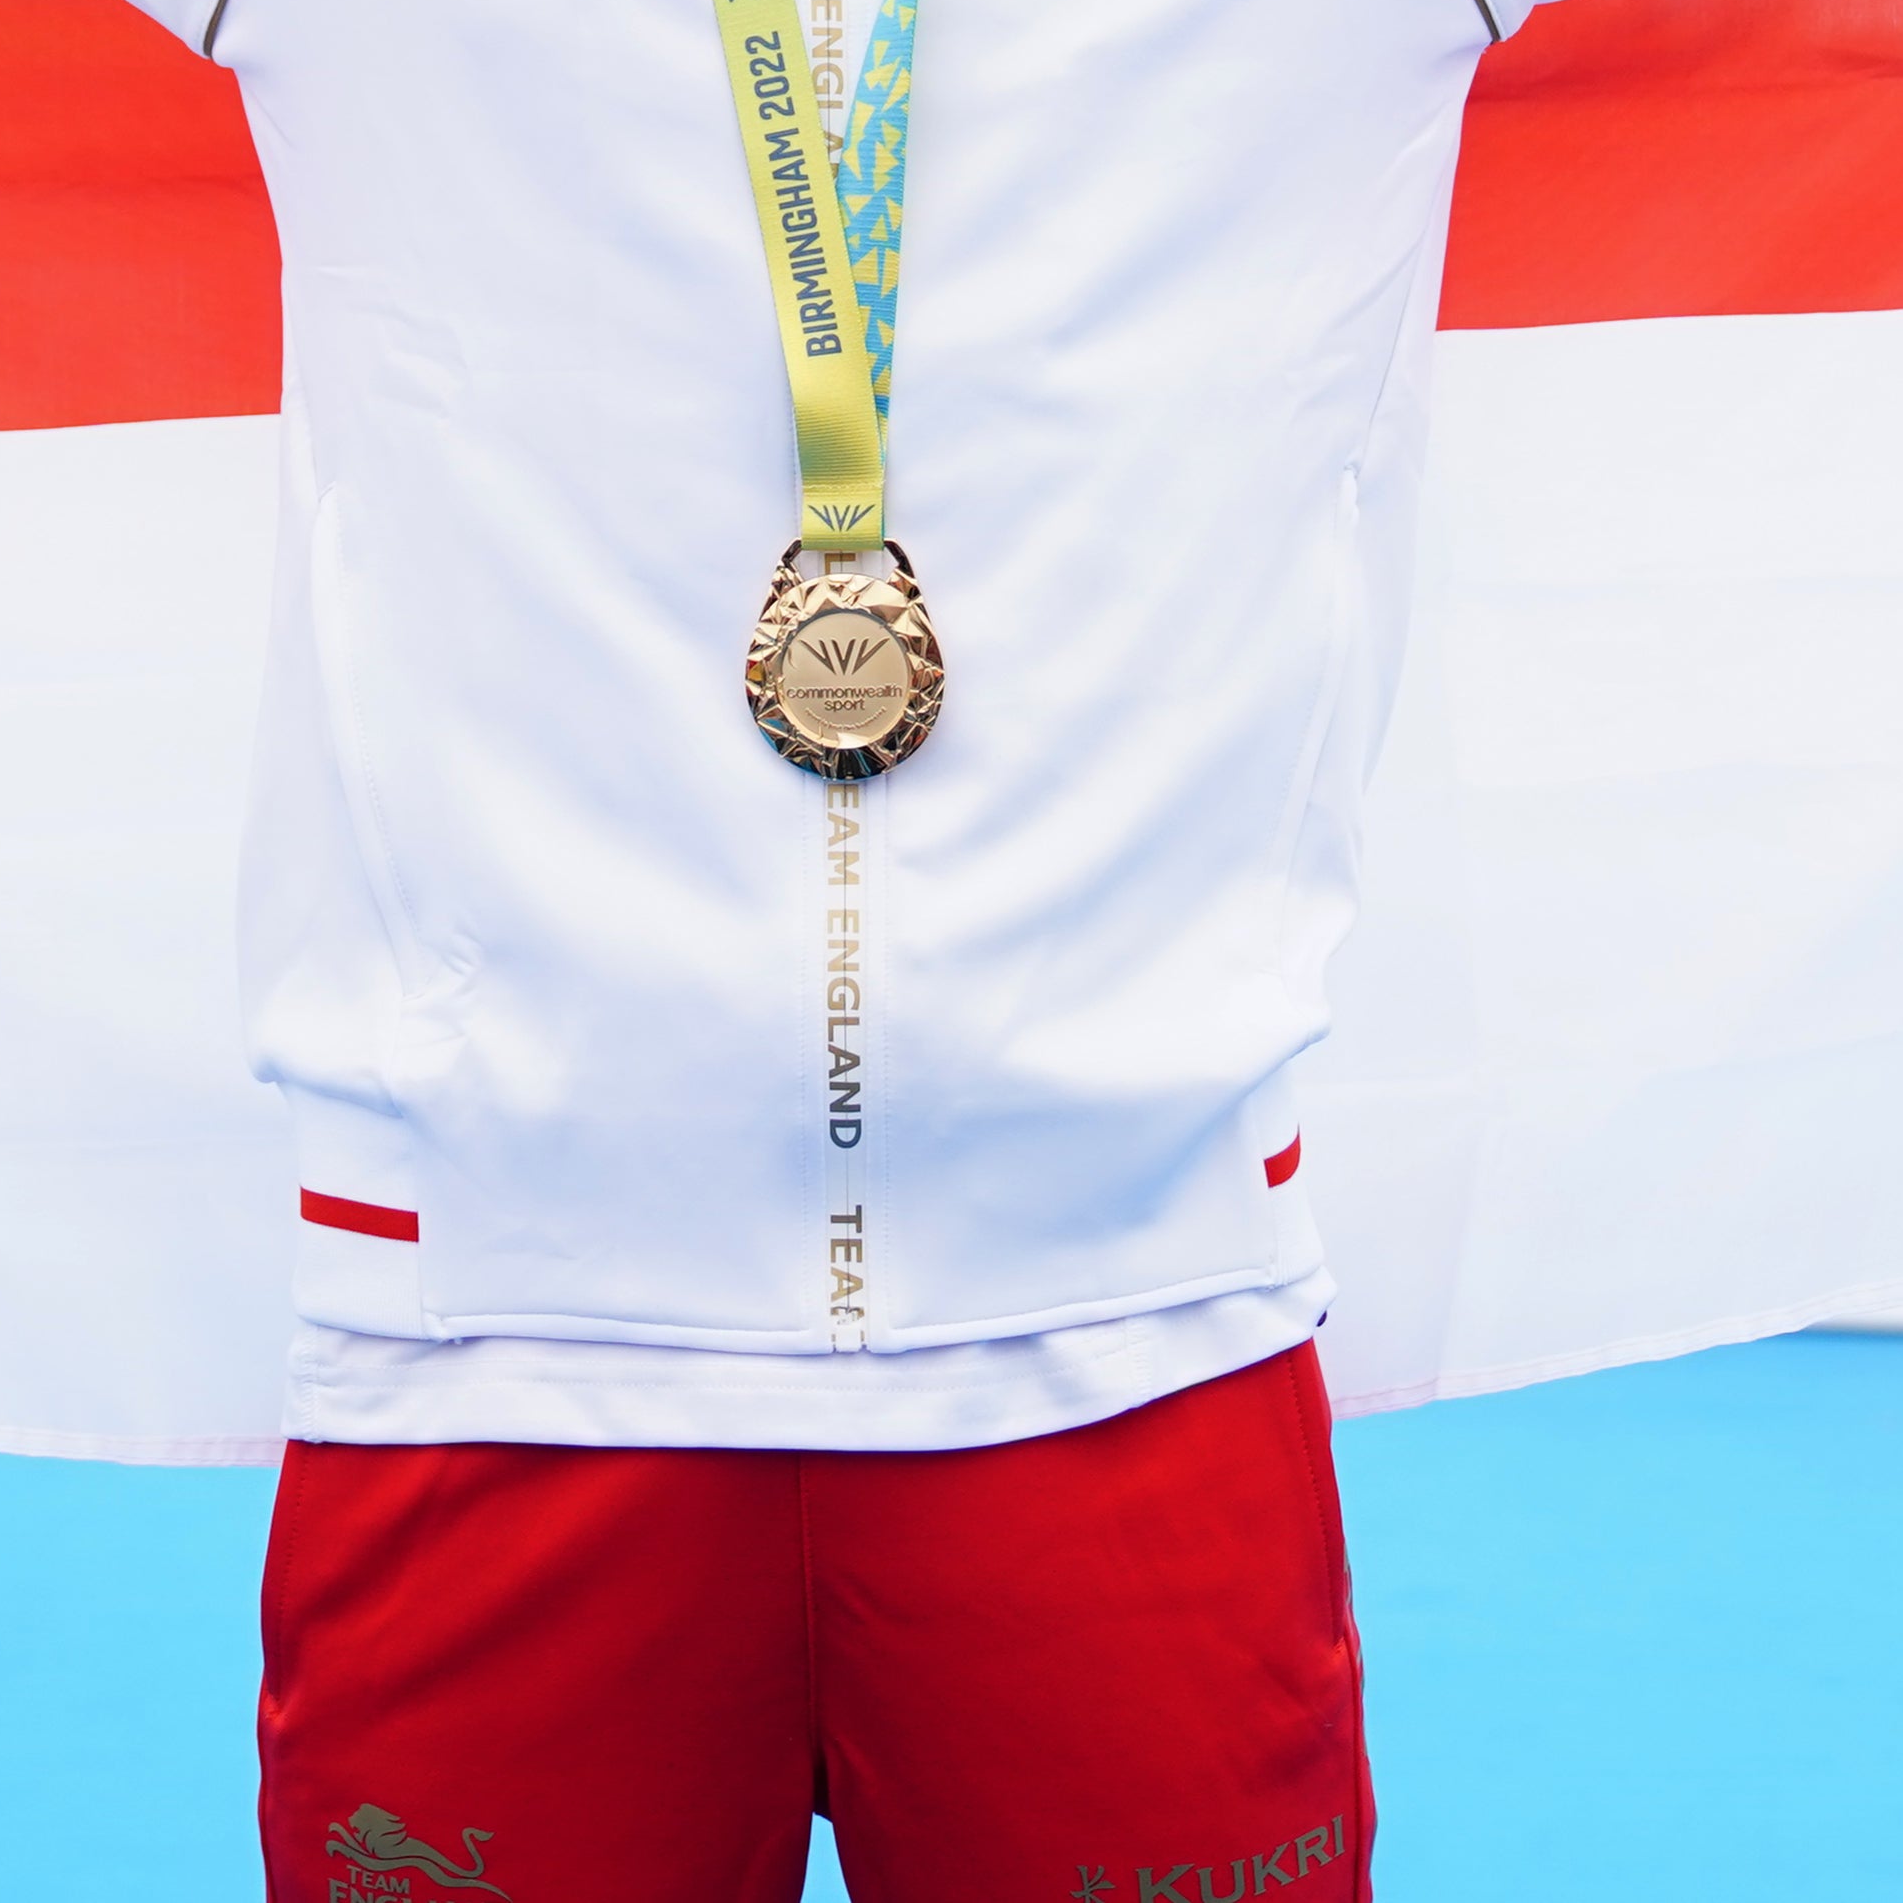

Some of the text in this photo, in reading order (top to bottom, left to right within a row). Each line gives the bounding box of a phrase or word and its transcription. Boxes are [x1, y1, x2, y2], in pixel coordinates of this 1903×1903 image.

[744, 31, 843, 357] BIRMINGHAM 2022
[785, 683, 903, 700] commonwealth
[824, 698, 866, 713] sport
[827, 783, 862, 1148] EAM ENGLAND
[347, 1864, 410, 1895] TEAM
[1135, 1814, 1345, 1903] KUKRI
